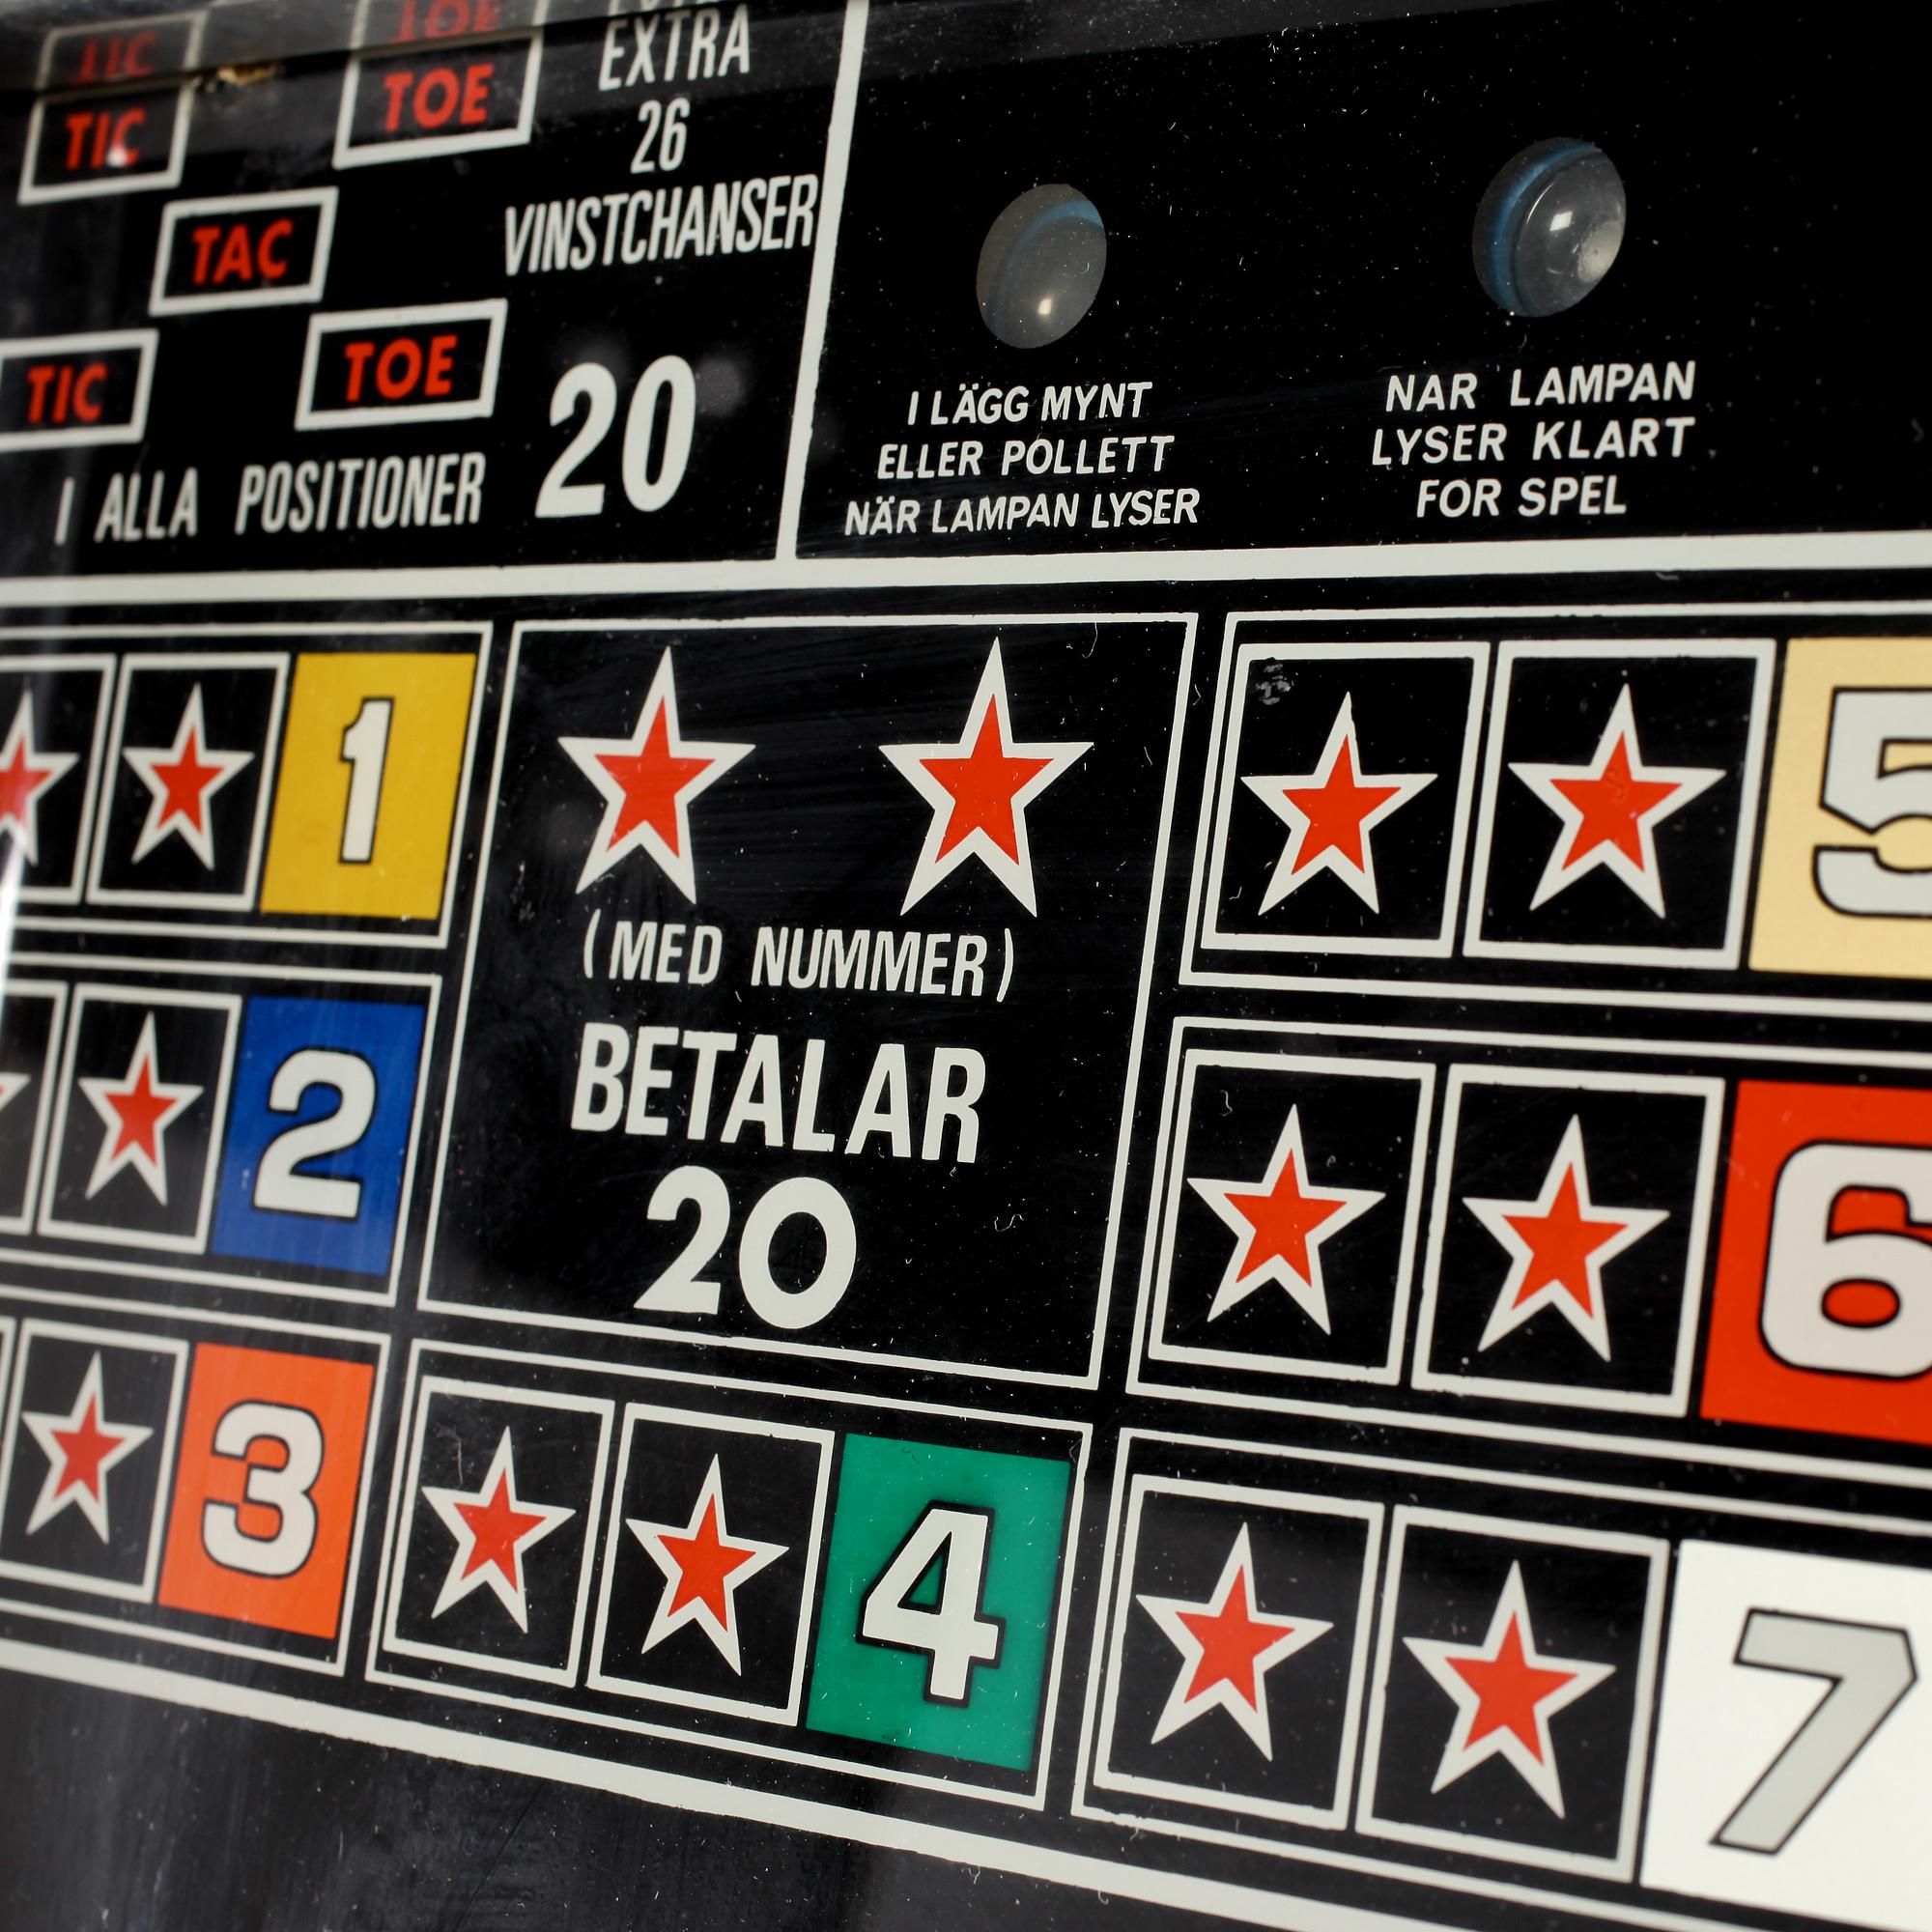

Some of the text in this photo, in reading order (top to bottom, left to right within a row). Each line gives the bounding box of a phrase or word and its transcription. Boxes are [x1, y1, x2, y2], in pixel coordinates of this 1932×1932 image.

[598, 4, 751, 92] EXTRA
[65, 107, 147, 171] TIC
[384, 63, 495, 131] TOE
[630, 97, 691, 174] 26
[191, 218, 294, 285] TAC
[505, 173, 819, 276] VINSTCHANSER
[26, 362, 108, 424] TIC
[343, 333, 459, 403] TOE
[907, 381, 1153, 425] I LÄGG MYNT
[1385, 360, 1696, 412] NAR LAMPAN
[535, 355, 696, 519] 20
[877, 435, 1176, 480] ELLER POLLETT
[1372, 416, 1696, 466] LYSER KLART
[55, 451, 487, 545] I ALLA POSITIONER
[844, 487, 1201, 536] NÄR LAMPAN LYSER
[1416, 474, 1627, 518] FOR SPEL
[338, 696, 394, 865] 1
[1811, 684, 1932, 923] 5
[251, 1044, 378, 1220] 2
[570, 1022, 986, 1164] BETALAR
[633, 1165, 858, 1330] 20
[1757, 1138, 1932, 1381] 6
[200, 1400, 325, 1580] 3
[858, 1500, 1006, 1708] 4
[1708, 1606, 1919, 1856] 7
